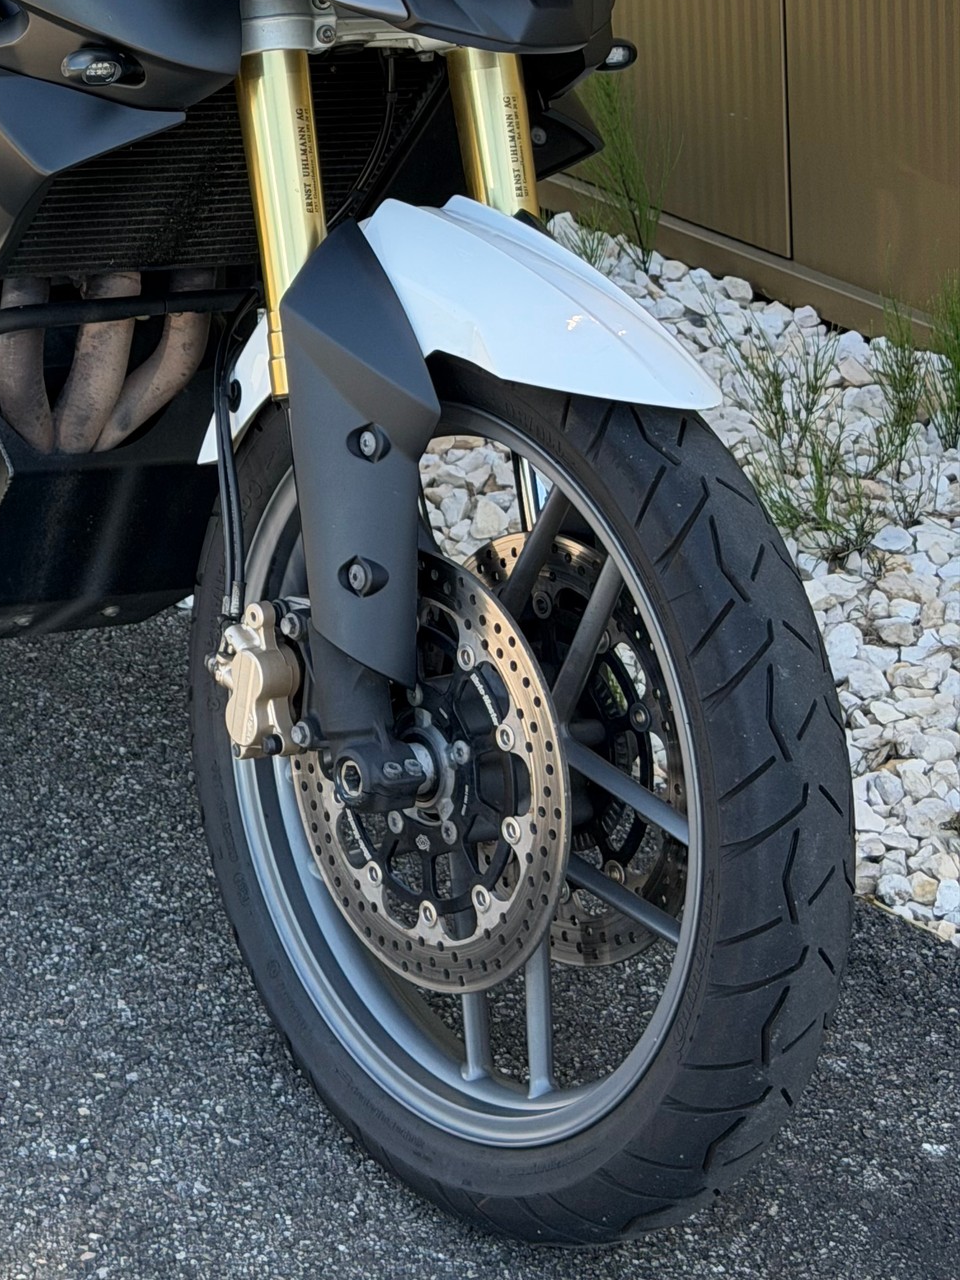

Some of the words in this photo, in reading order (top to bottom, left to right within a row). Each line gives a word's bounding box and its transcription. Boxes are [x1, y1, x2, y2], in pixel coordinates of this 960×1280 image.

[296, 108, 305, 121] AG
[503, 96, 513, 109] AG
[297, 126, 310, 178] UHLMANN
[505, 114, 519, 163] UHLMANN
[512, 168, 524, 198] ERNST
[304, 183, 314, 214] ERNST
